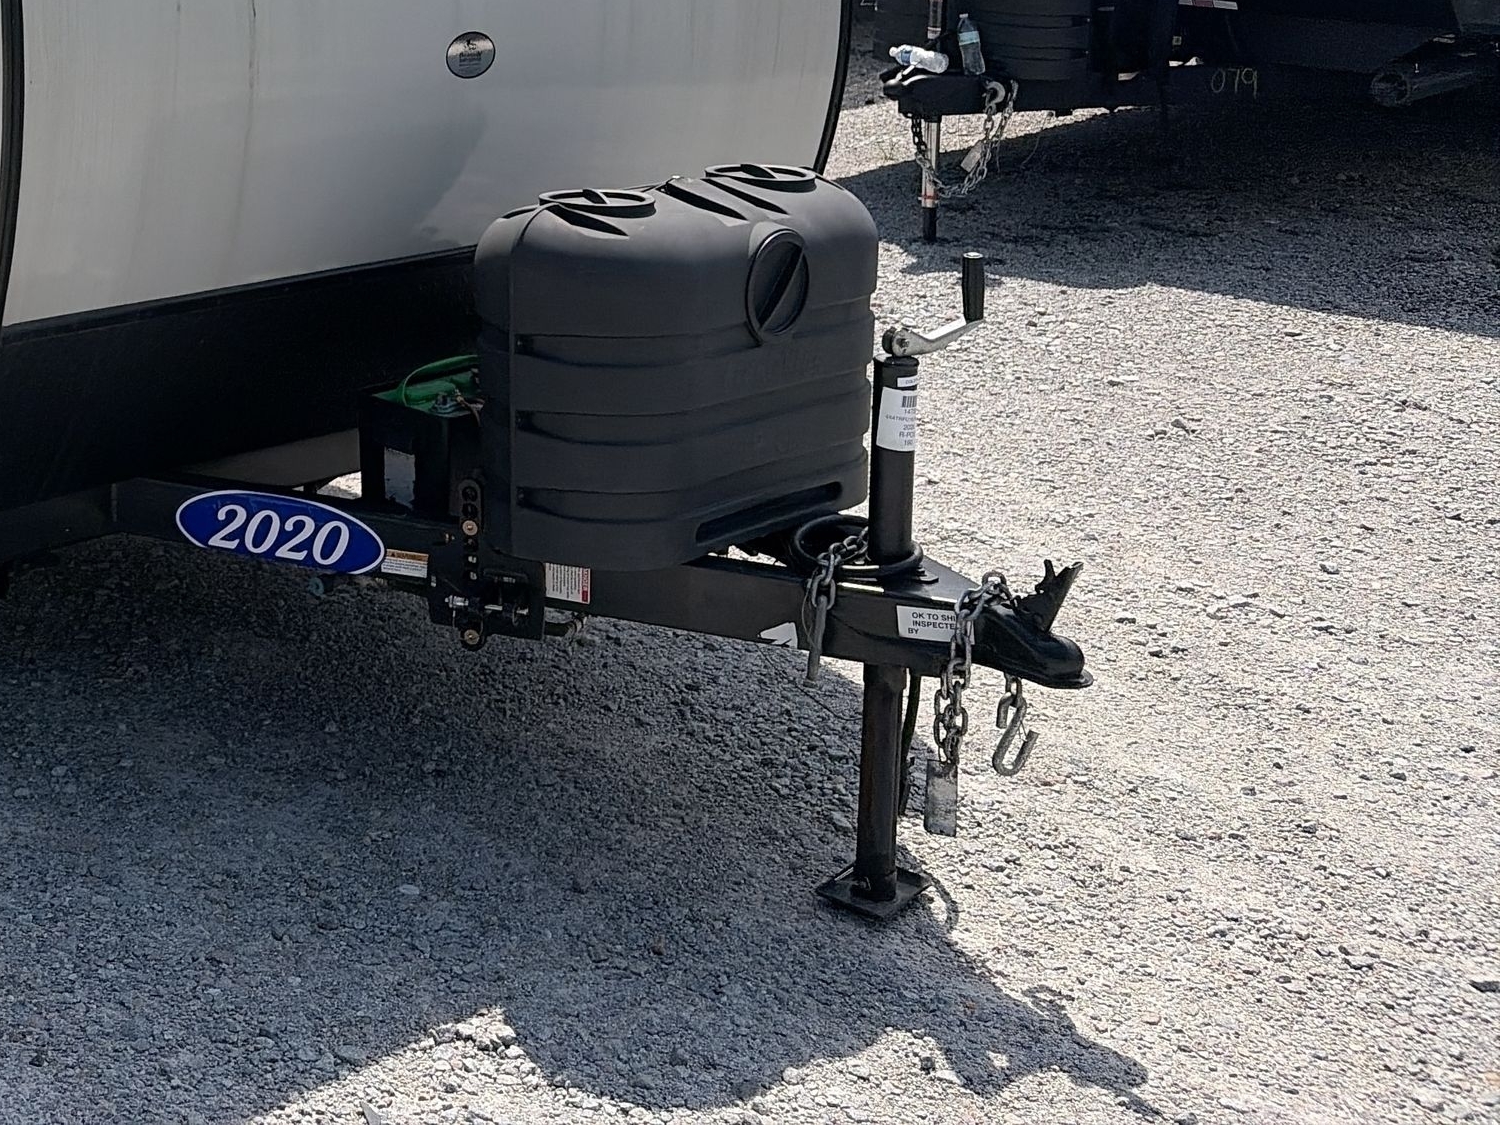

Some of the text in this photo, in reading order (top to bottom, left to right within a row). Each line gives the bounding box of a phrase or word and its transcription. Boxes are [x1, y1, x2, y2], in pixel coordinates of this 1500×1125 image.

[1211, 67, 1257, 100] 079
[208, 504, 350, 565] 2020
[912, 620, 957, 631] INSPECTE
[927, 613, 939, 621] TO
